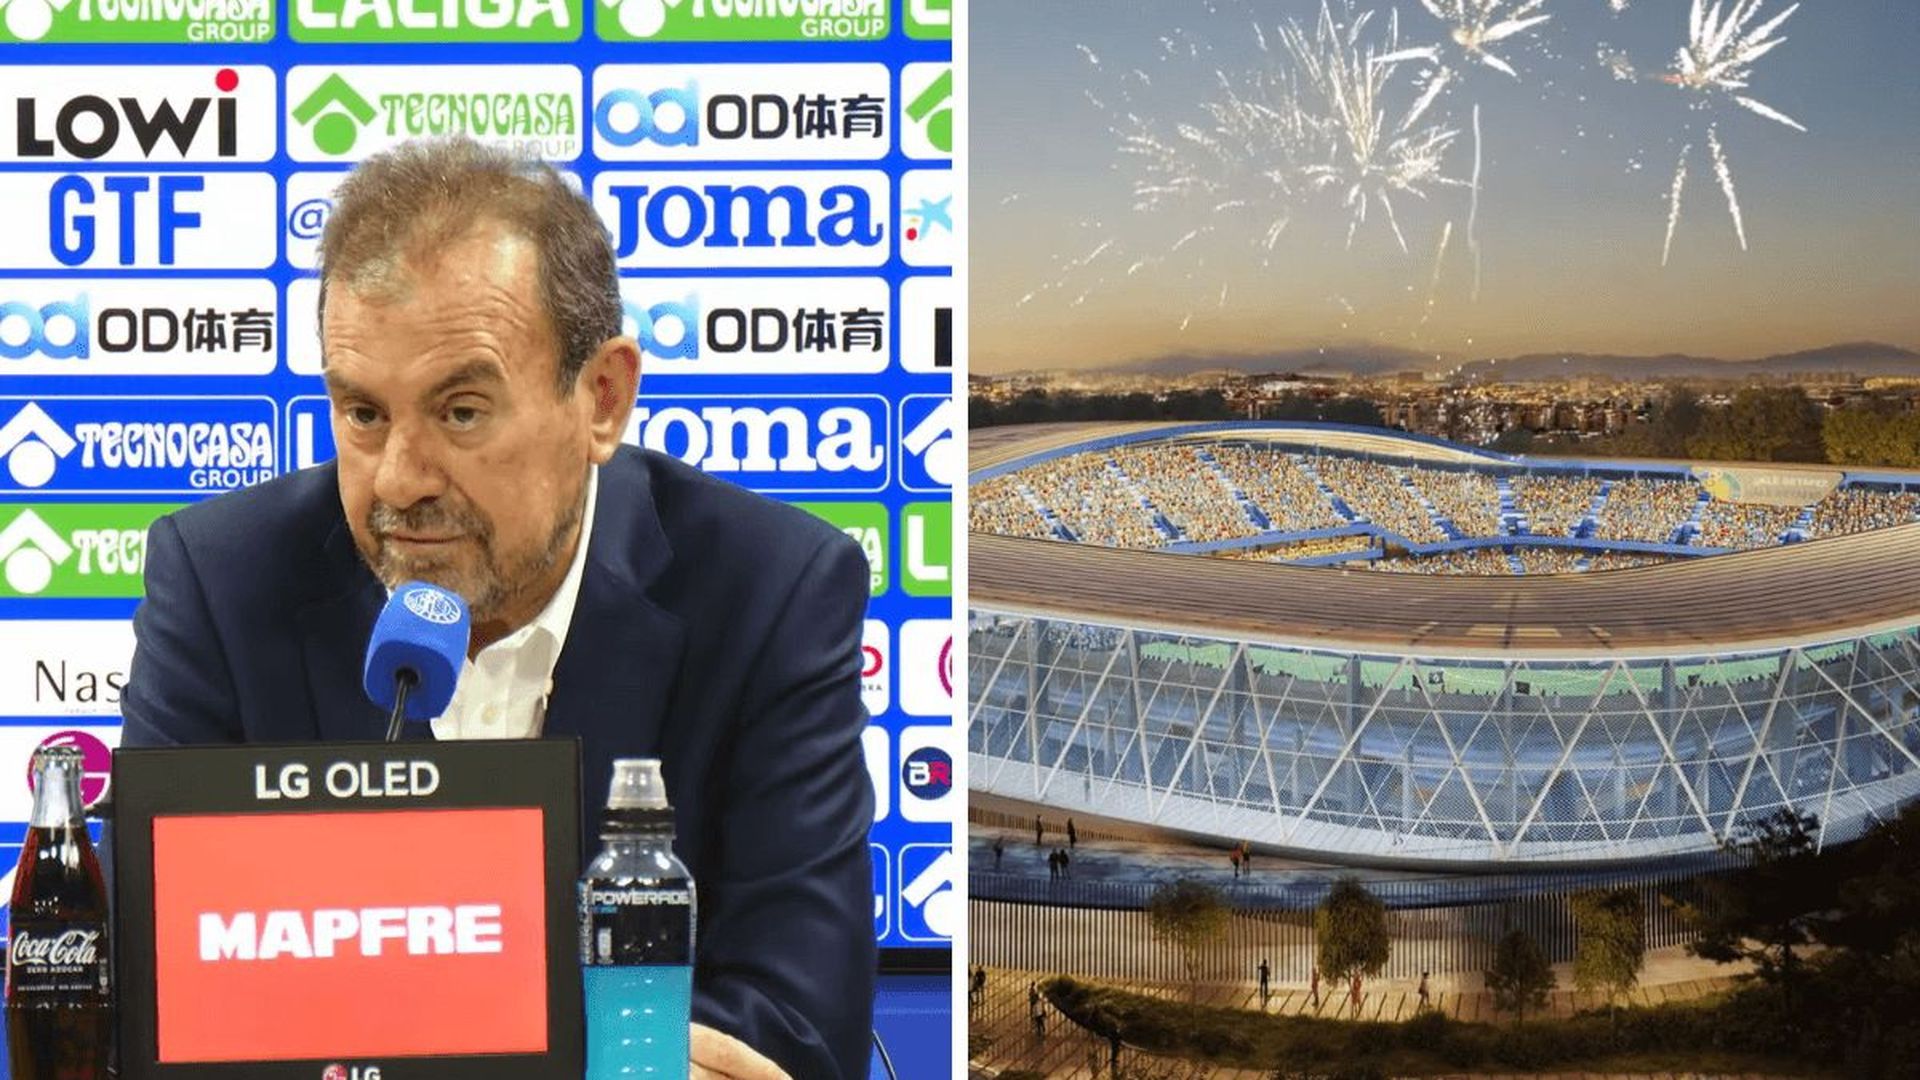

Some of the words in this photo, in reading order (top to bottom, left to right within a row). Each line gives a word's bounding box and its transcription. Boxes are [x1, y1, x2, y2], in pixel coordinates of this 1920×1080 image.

[187, 22, 271, 42] GROUP
[801, 18, 885, 38] GROUP
[379, 92, 576, 137] TECNOCASA
[49, 175, 205, 266] GTF
[75, 421, 273, 468] TECNOCASA
[189, 468, 273, 488] GROUP
[255, 763, 310, 800] LG
[325, 760, 441, 798] OLED
[592, 889, 691, 906] POWERADE
[199, 903, 503, 963] MAPFRE
